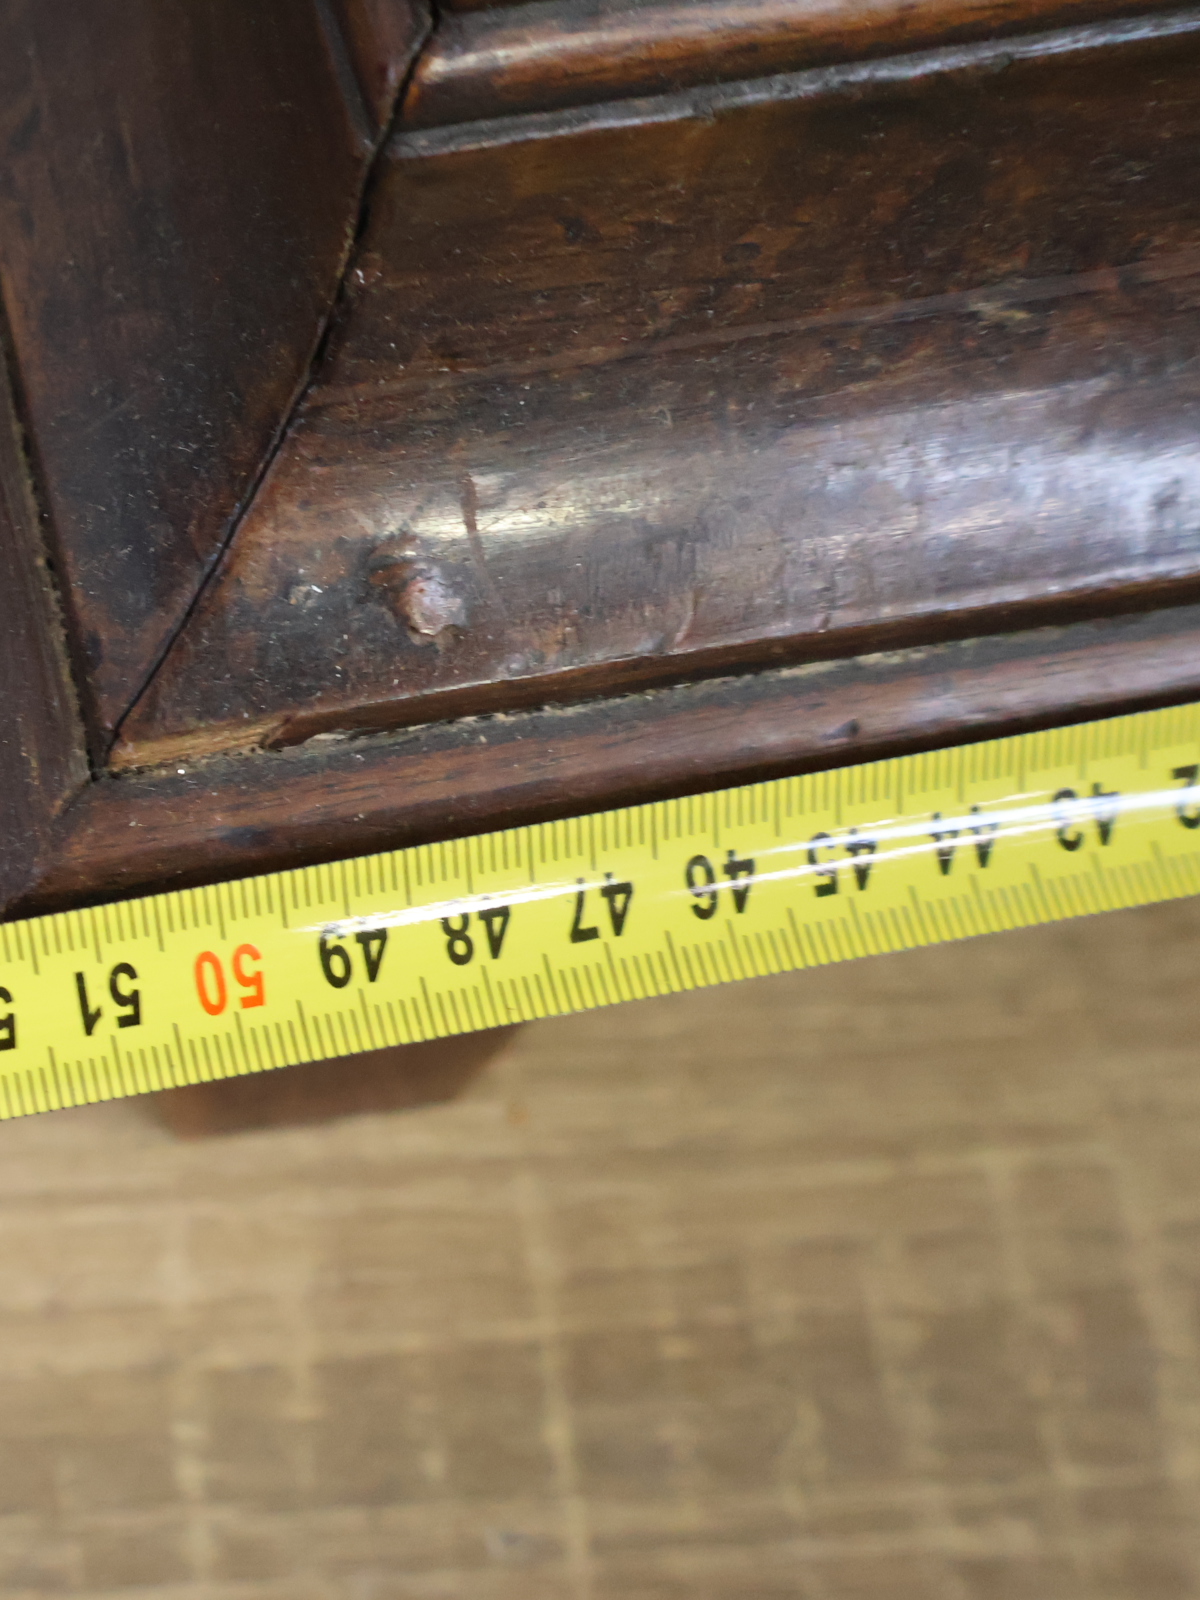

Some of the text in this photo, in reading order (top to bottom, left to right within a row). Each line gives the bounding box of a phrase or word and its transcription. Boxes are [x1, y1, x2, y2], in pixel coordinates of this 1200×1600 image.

[930, 806, 998, 876] 44
[1052, 783, 1120, 852] 43
[685, 849, 755, 920] 46
[807, 828, 877, 897] 45
[441, 894, 510, 966] 48
[569, 872, 634, 944] 47
[194, 944, 266, 1016] 50
[319, 917, 388, 989] 49
[75, 962, 141, 1036] 51
